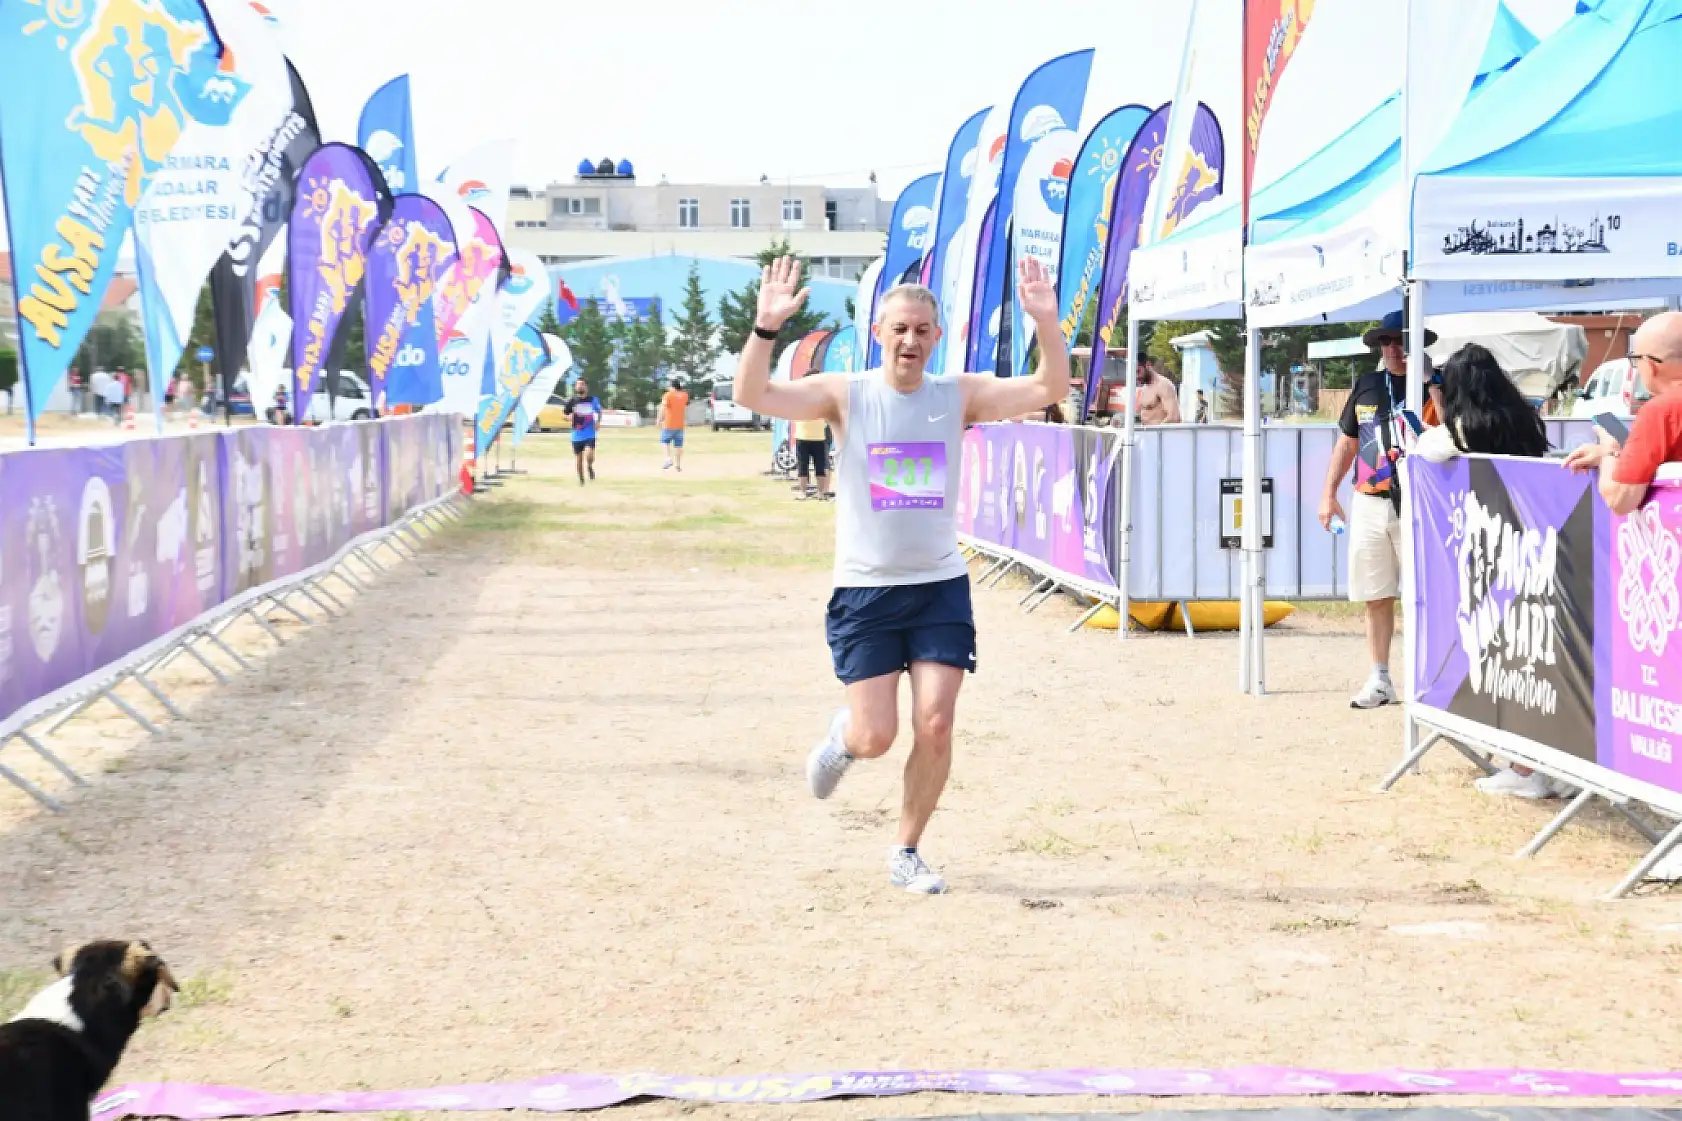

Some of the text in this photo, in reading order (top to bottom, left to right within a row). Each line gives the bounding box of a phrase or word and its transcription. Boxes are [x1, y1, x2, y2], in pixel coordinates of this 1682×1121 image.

[1607, 214, 1621, 231] 10
[17, 214, 106, 350] AUSA
[883, 456, 933, 488] 237
[1496, 522, 1558, 601] AUSA
[1504, 599, 1557, 666] YARI
